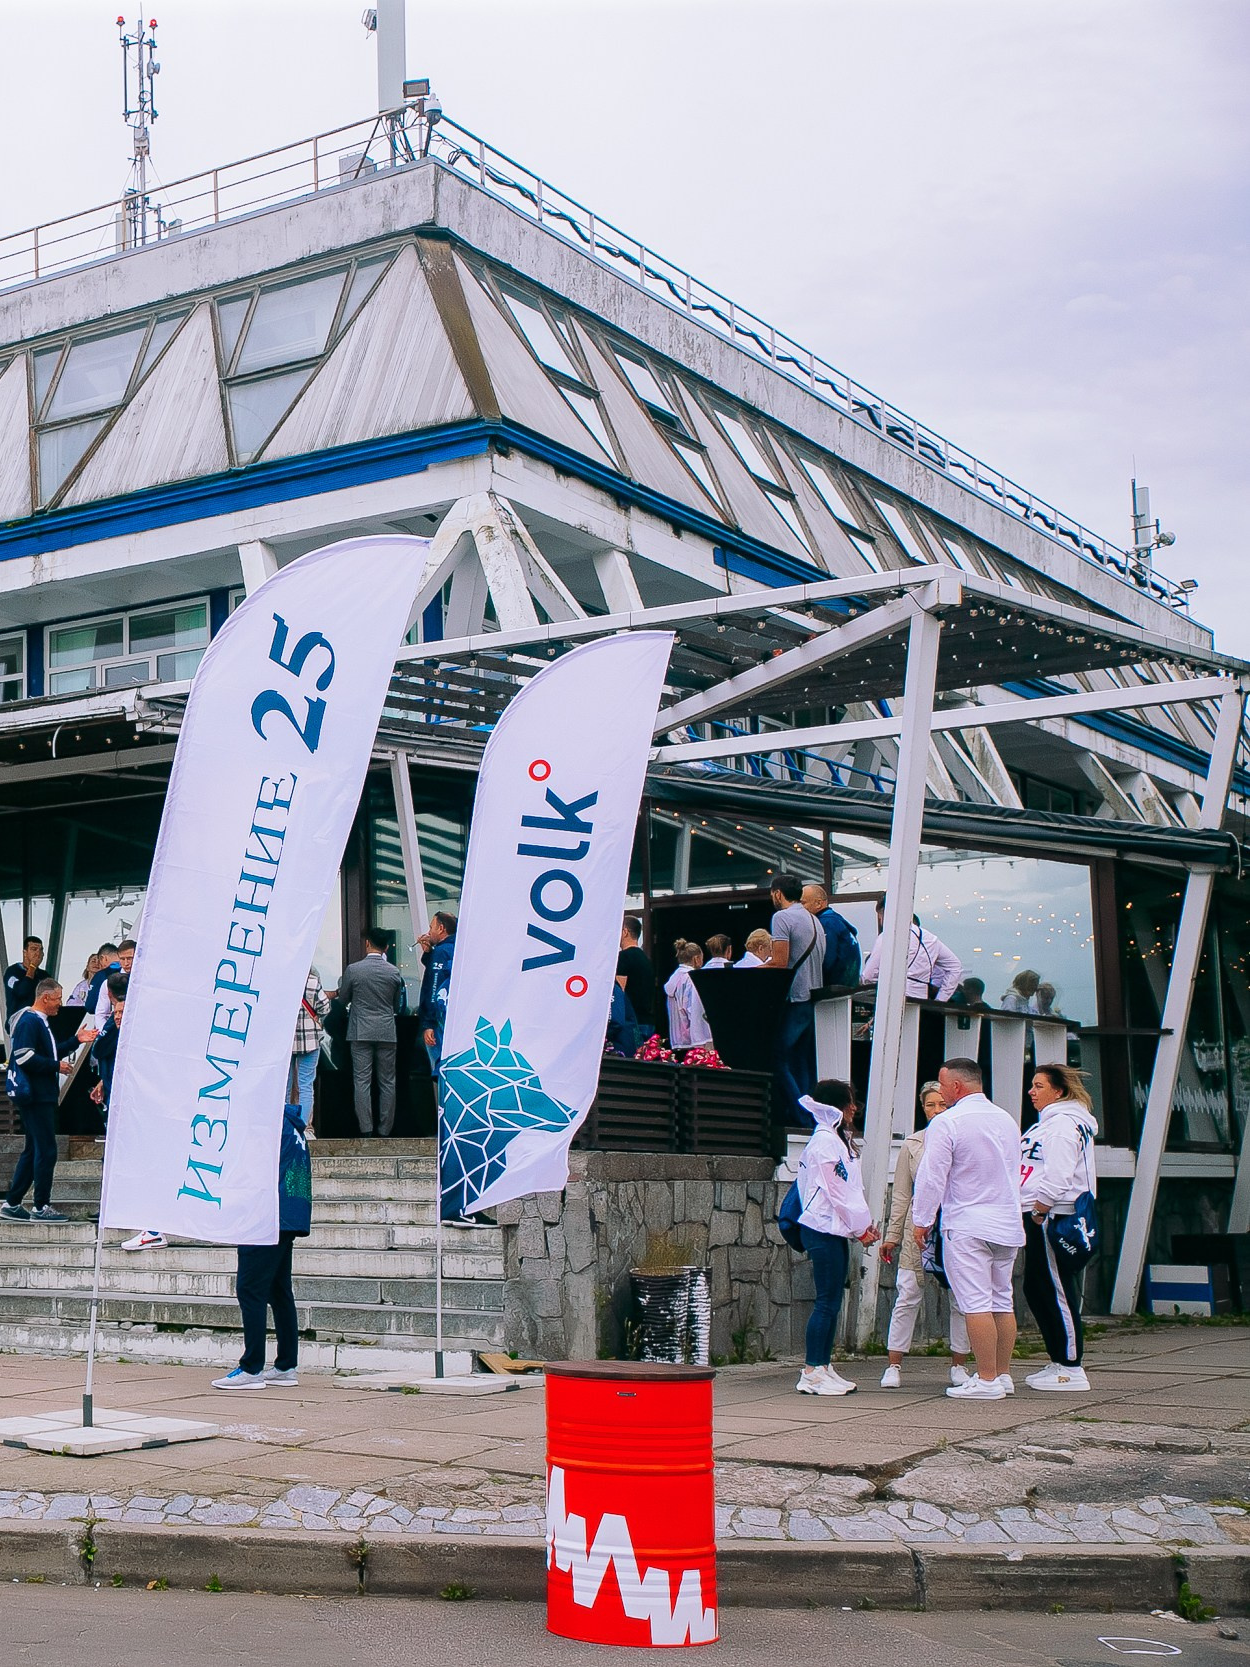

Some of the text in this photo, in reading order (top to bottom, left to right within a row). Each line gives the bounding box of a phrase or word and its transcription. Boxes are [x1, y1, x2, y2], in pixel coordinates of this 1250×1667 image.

[176, 612, 336, 1210] ИЗМЕРЕНИЕ 25
[517, 786, 599, 972] volk
[1059, 1237, 1077, 1255] volk
